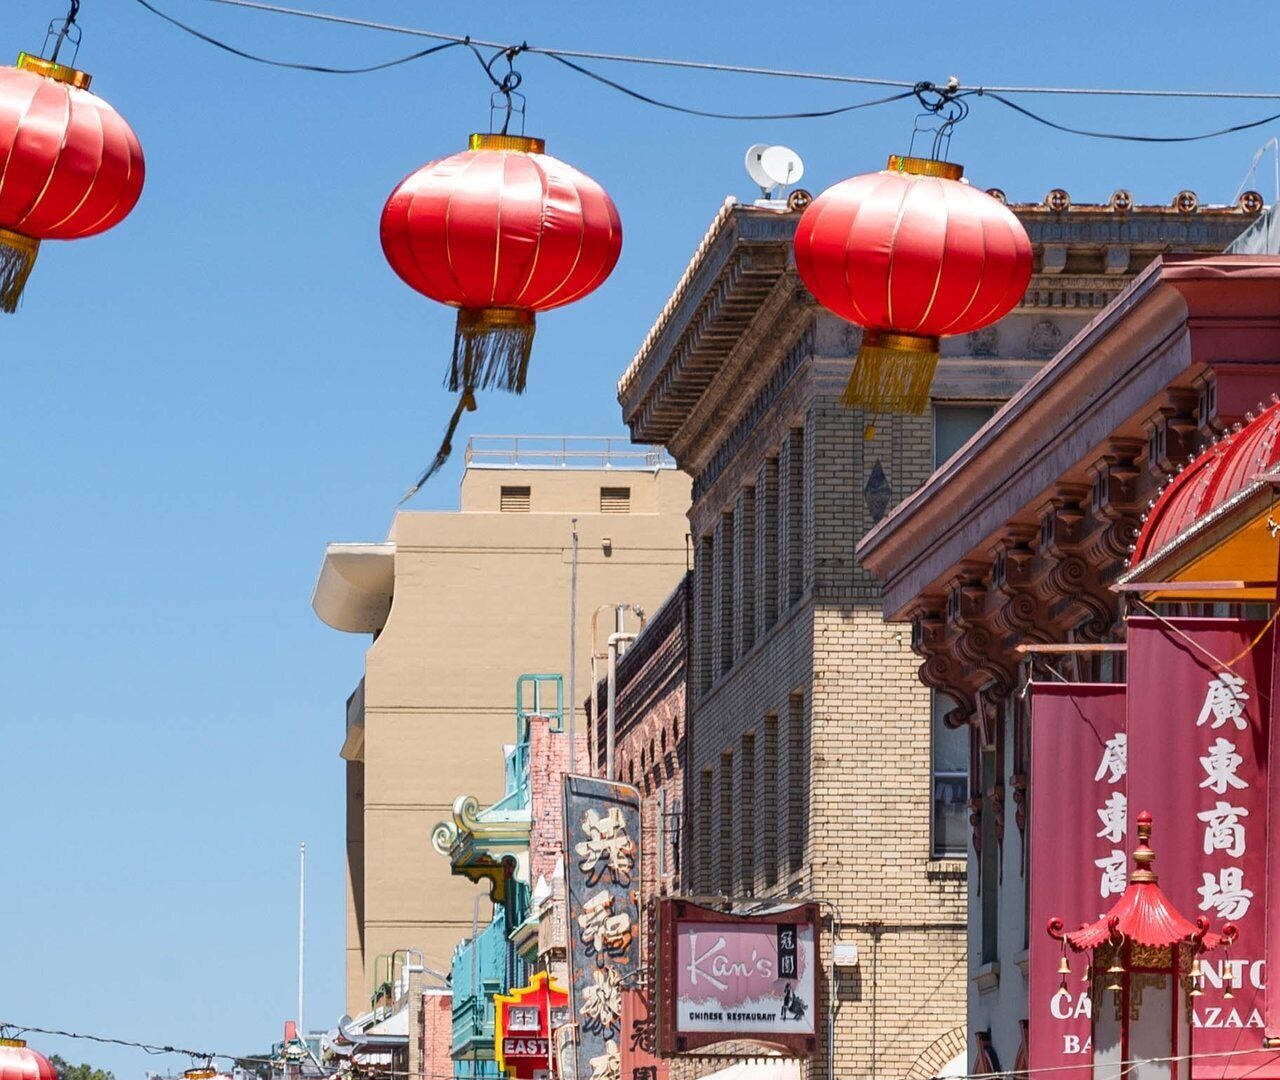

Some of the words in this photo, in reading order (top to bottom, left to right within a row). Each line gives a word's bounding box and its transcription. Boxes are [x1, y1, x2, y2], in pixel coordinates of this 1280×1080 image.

[1094, 731, 1127, 924] 廣東商
[1194, 672, 1254, 921] 廣東商場
[686, 928, 773, 992] Kan's
[689, 1012, 723, 1022] CHINESE
